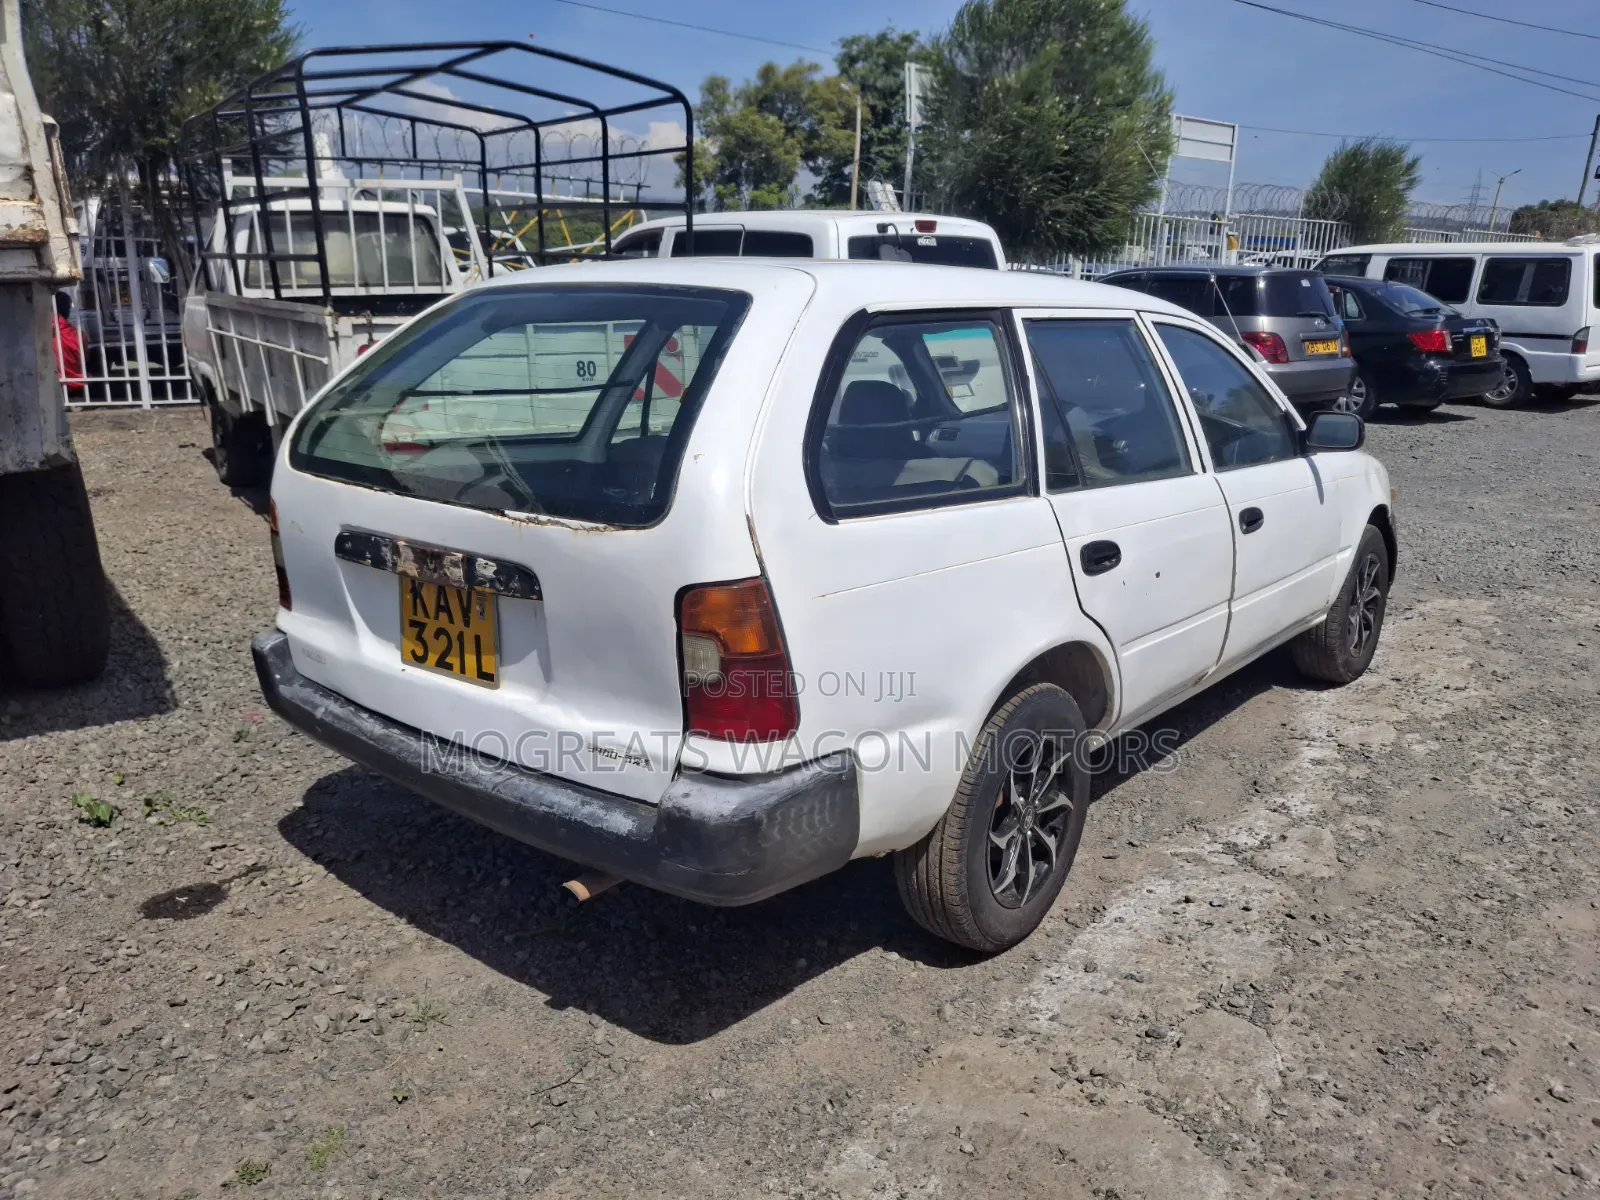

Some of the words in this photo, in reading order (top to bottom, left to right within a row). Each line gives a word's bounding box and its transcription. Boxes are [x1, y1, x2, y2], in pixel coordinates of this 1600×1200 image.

[576, 360, 596, 377] 80
[409, 578, 473, 628] KAV
[408, 618, 495, 682] 321L
